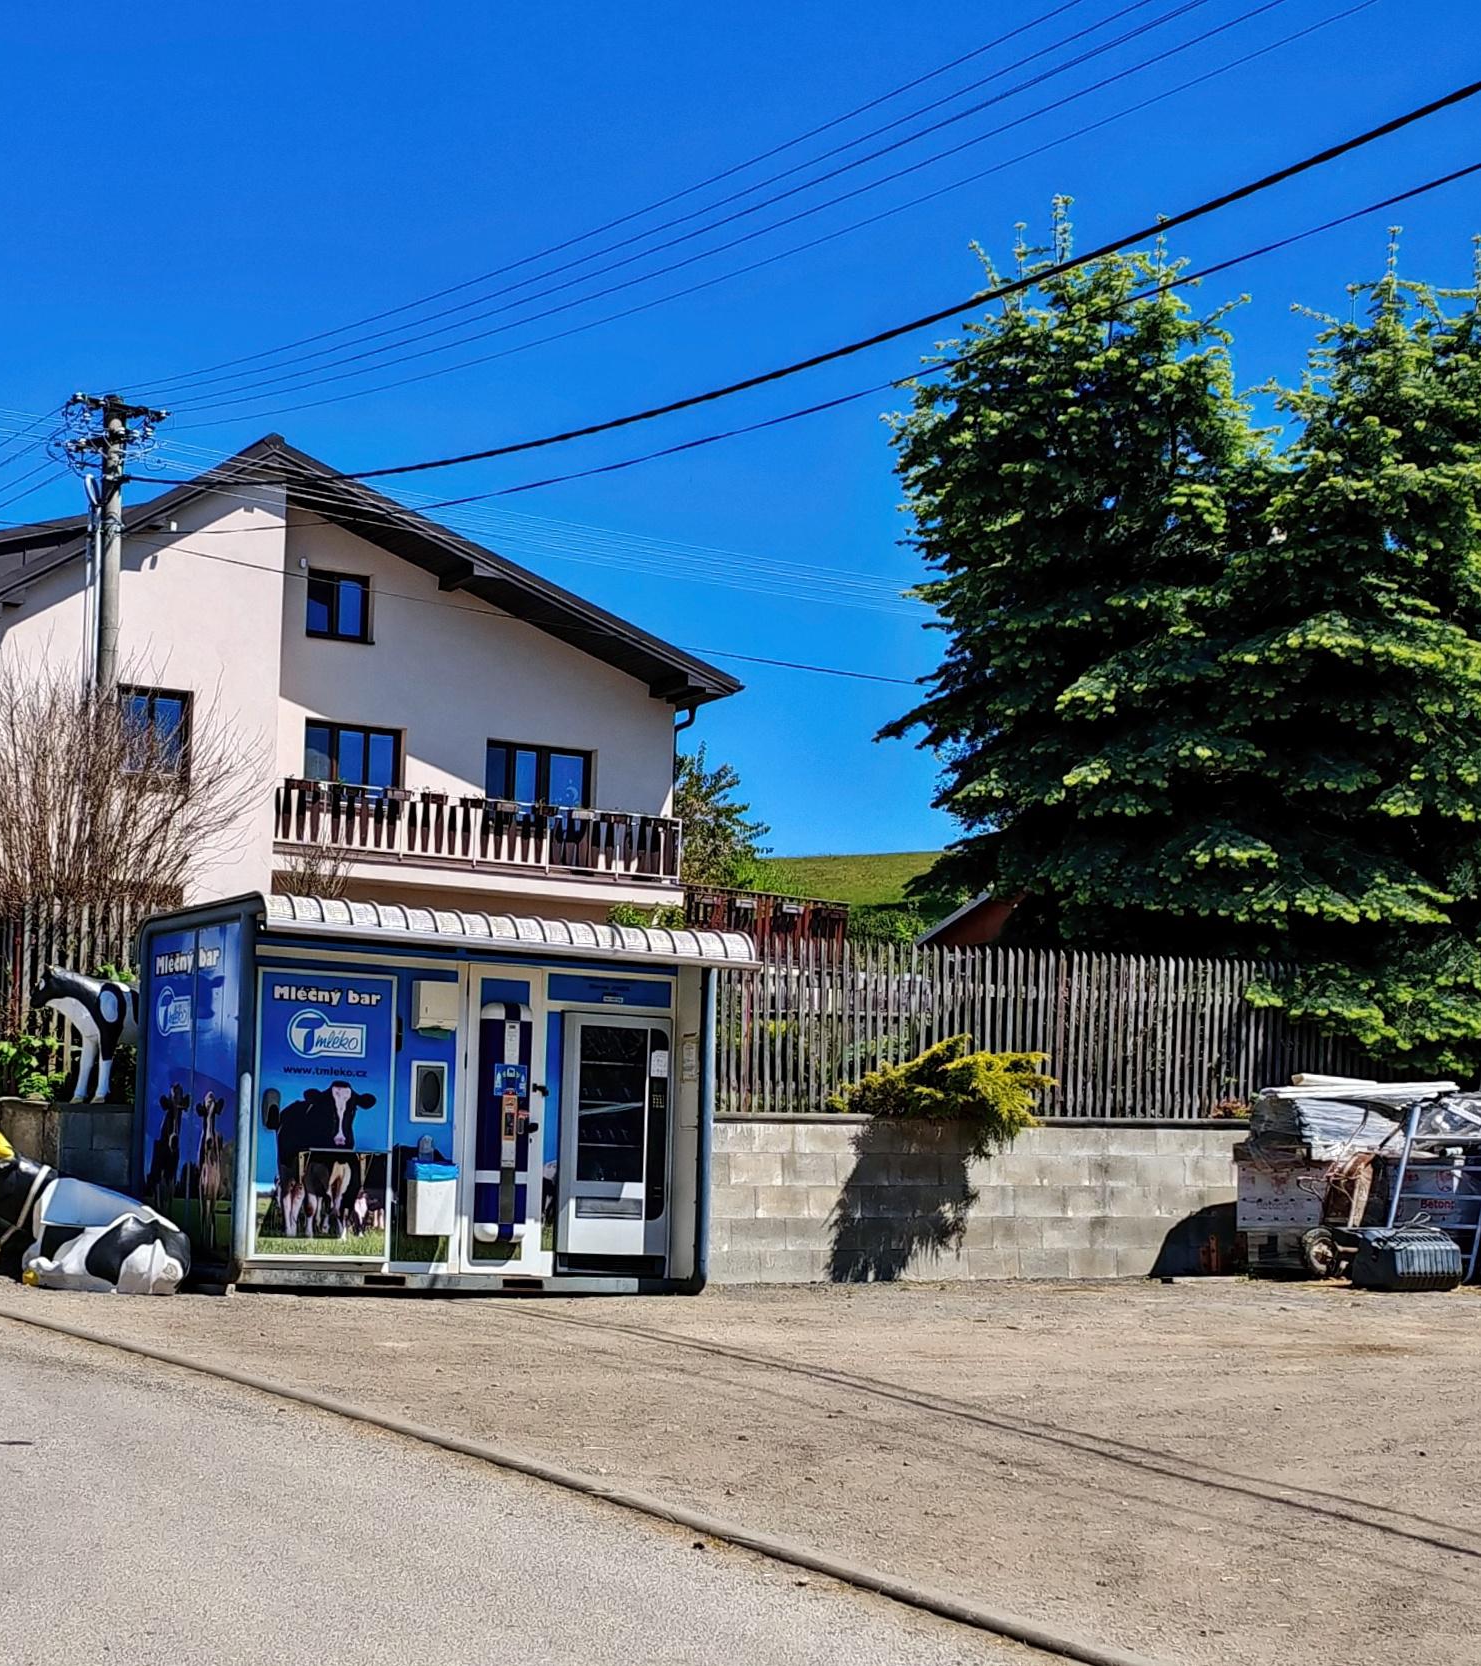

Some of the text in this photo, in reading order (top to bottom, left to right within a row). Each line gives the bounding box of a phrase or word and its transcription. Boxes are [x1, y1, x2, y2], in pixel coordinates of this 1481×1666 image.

[155, 947, 220, 975] Mléčný bar
[273, 985, 381, 1006] Mléčný bar
[283, 1066, 368, 1078] www.tmleko.cz
